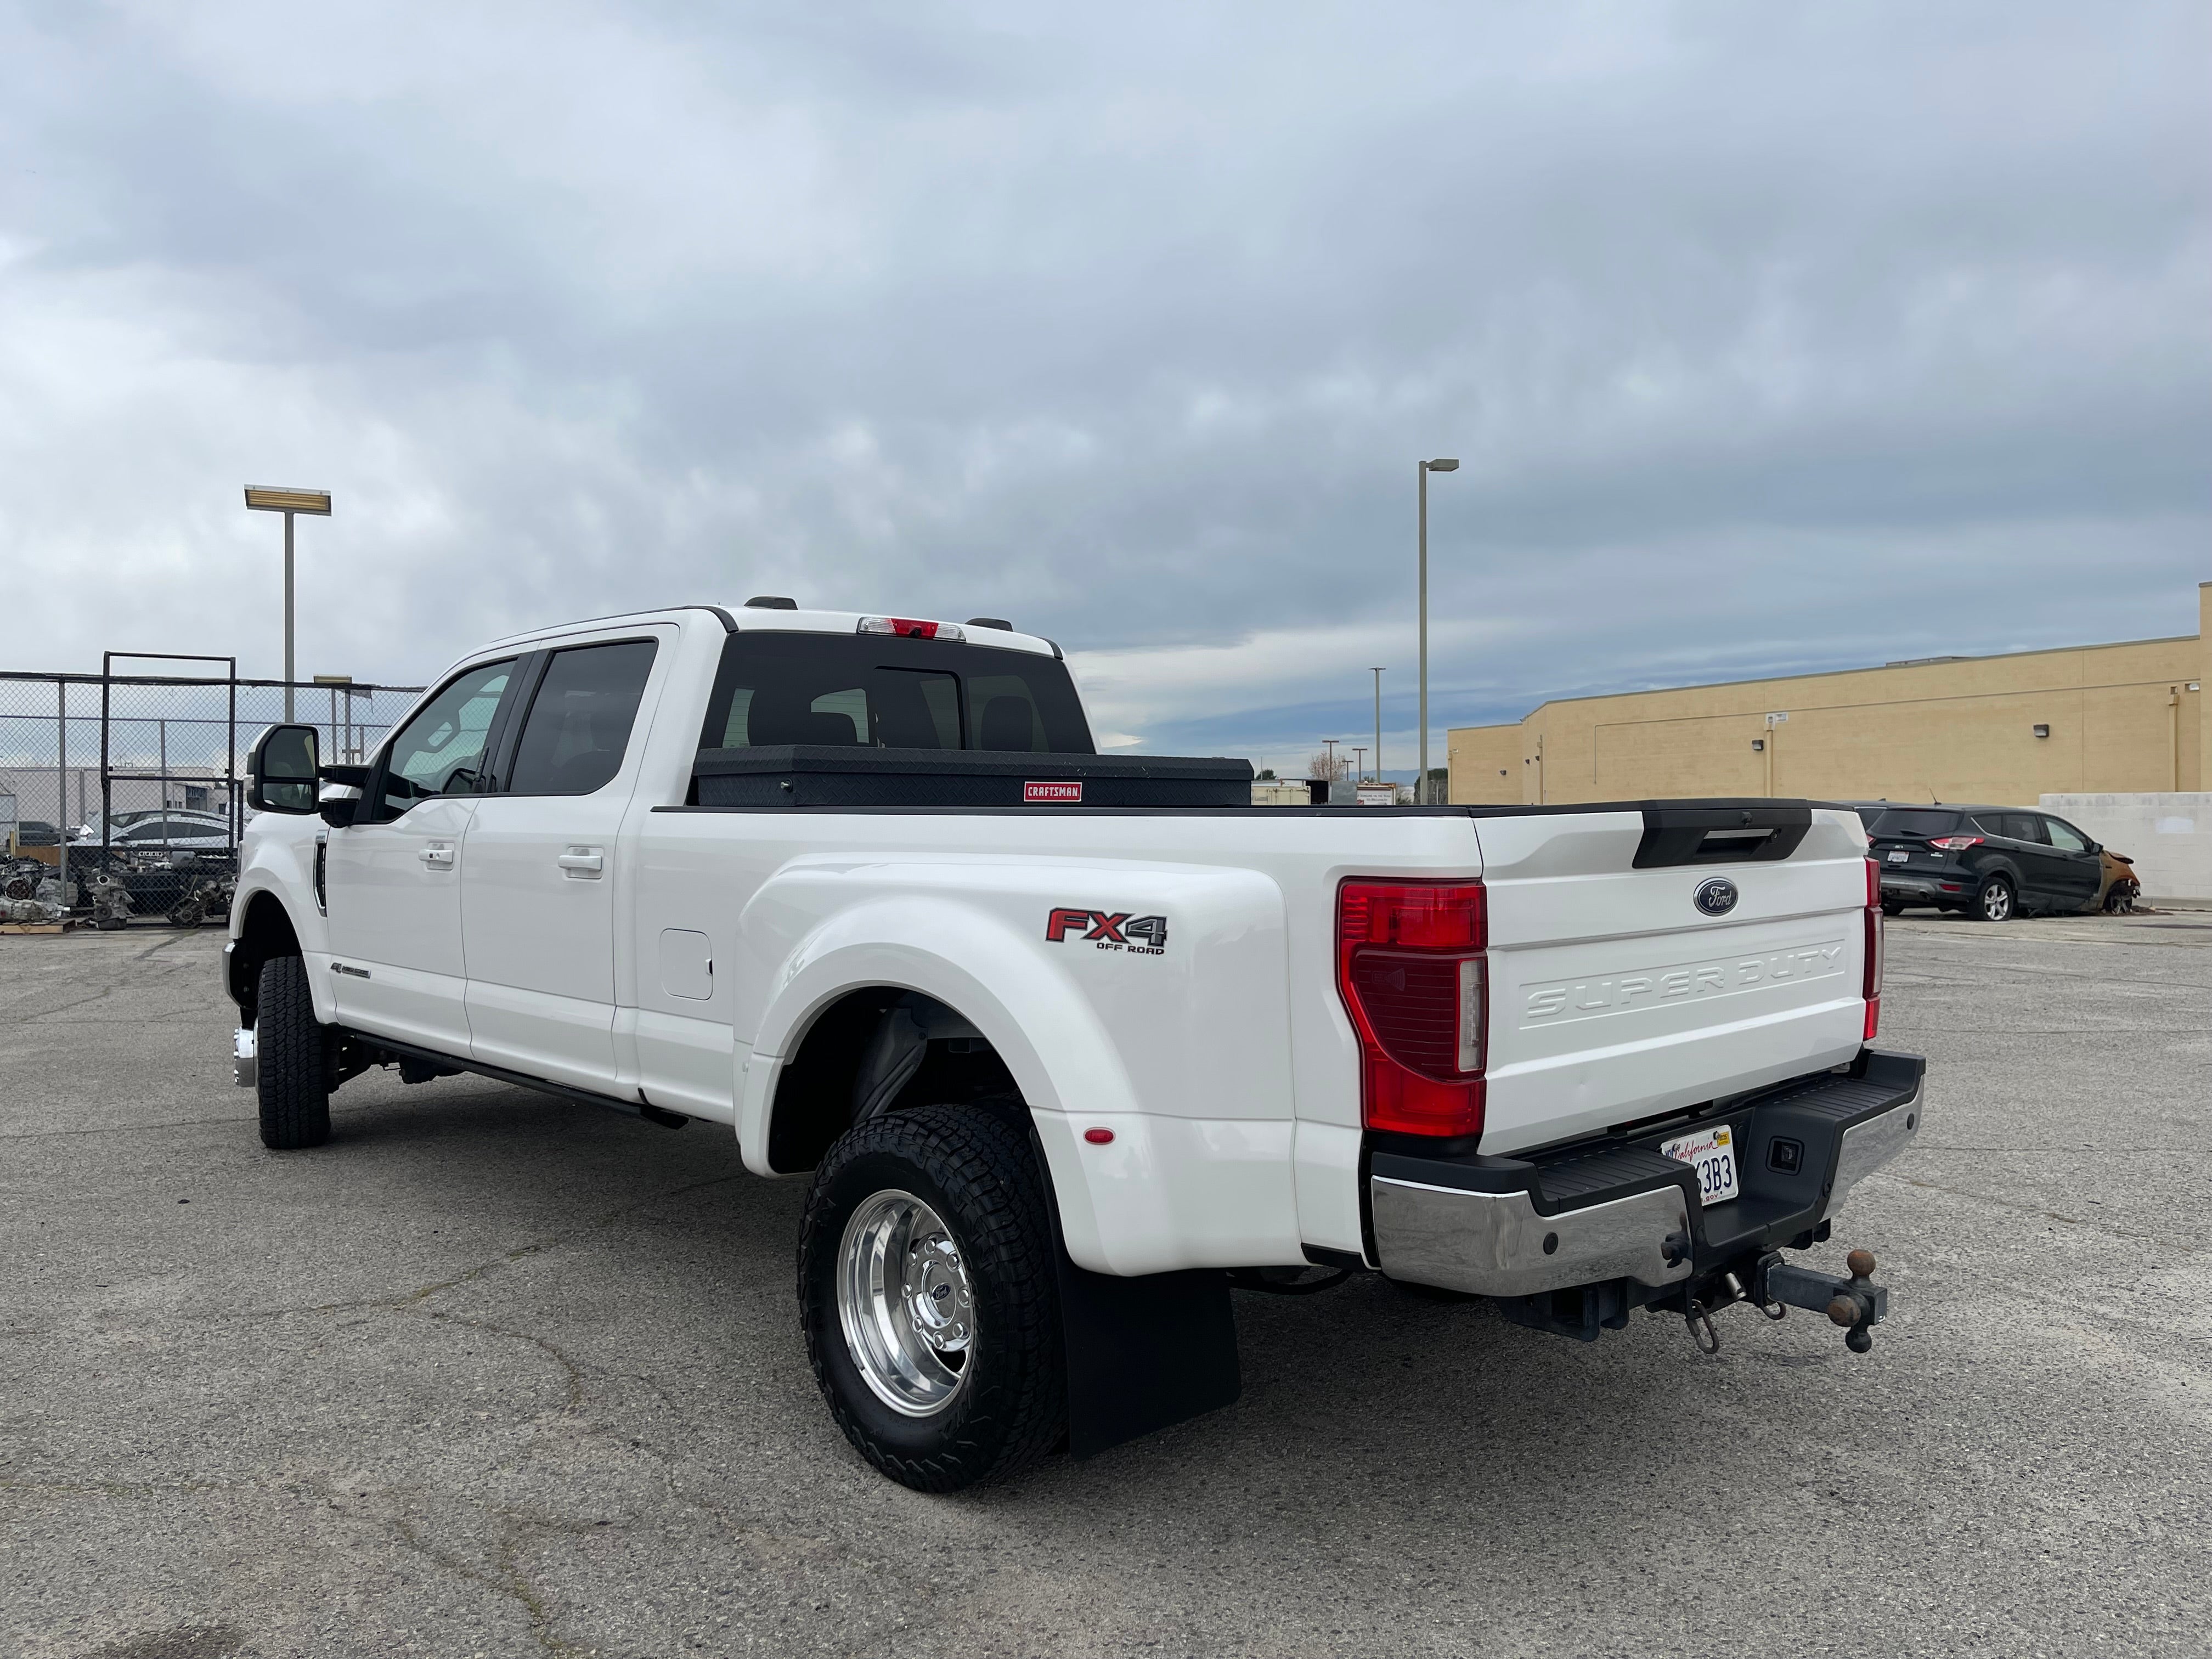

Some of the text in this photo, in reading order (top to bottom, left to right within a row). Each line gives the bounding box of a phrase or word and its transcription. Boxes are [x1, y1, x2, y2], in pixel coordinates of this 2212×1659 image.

[1028, 786, 1078, 797] CRAFTSMAN
[1708, 886, 1732, 907] Ford
[1046, 907, 1167, 947] FX4
[1096, 943, 1165, 956] OFF ROAD
[1527, 946, 1841, 1019] SUPER DUTY
[1674, 1140, 1719, 1162] California
